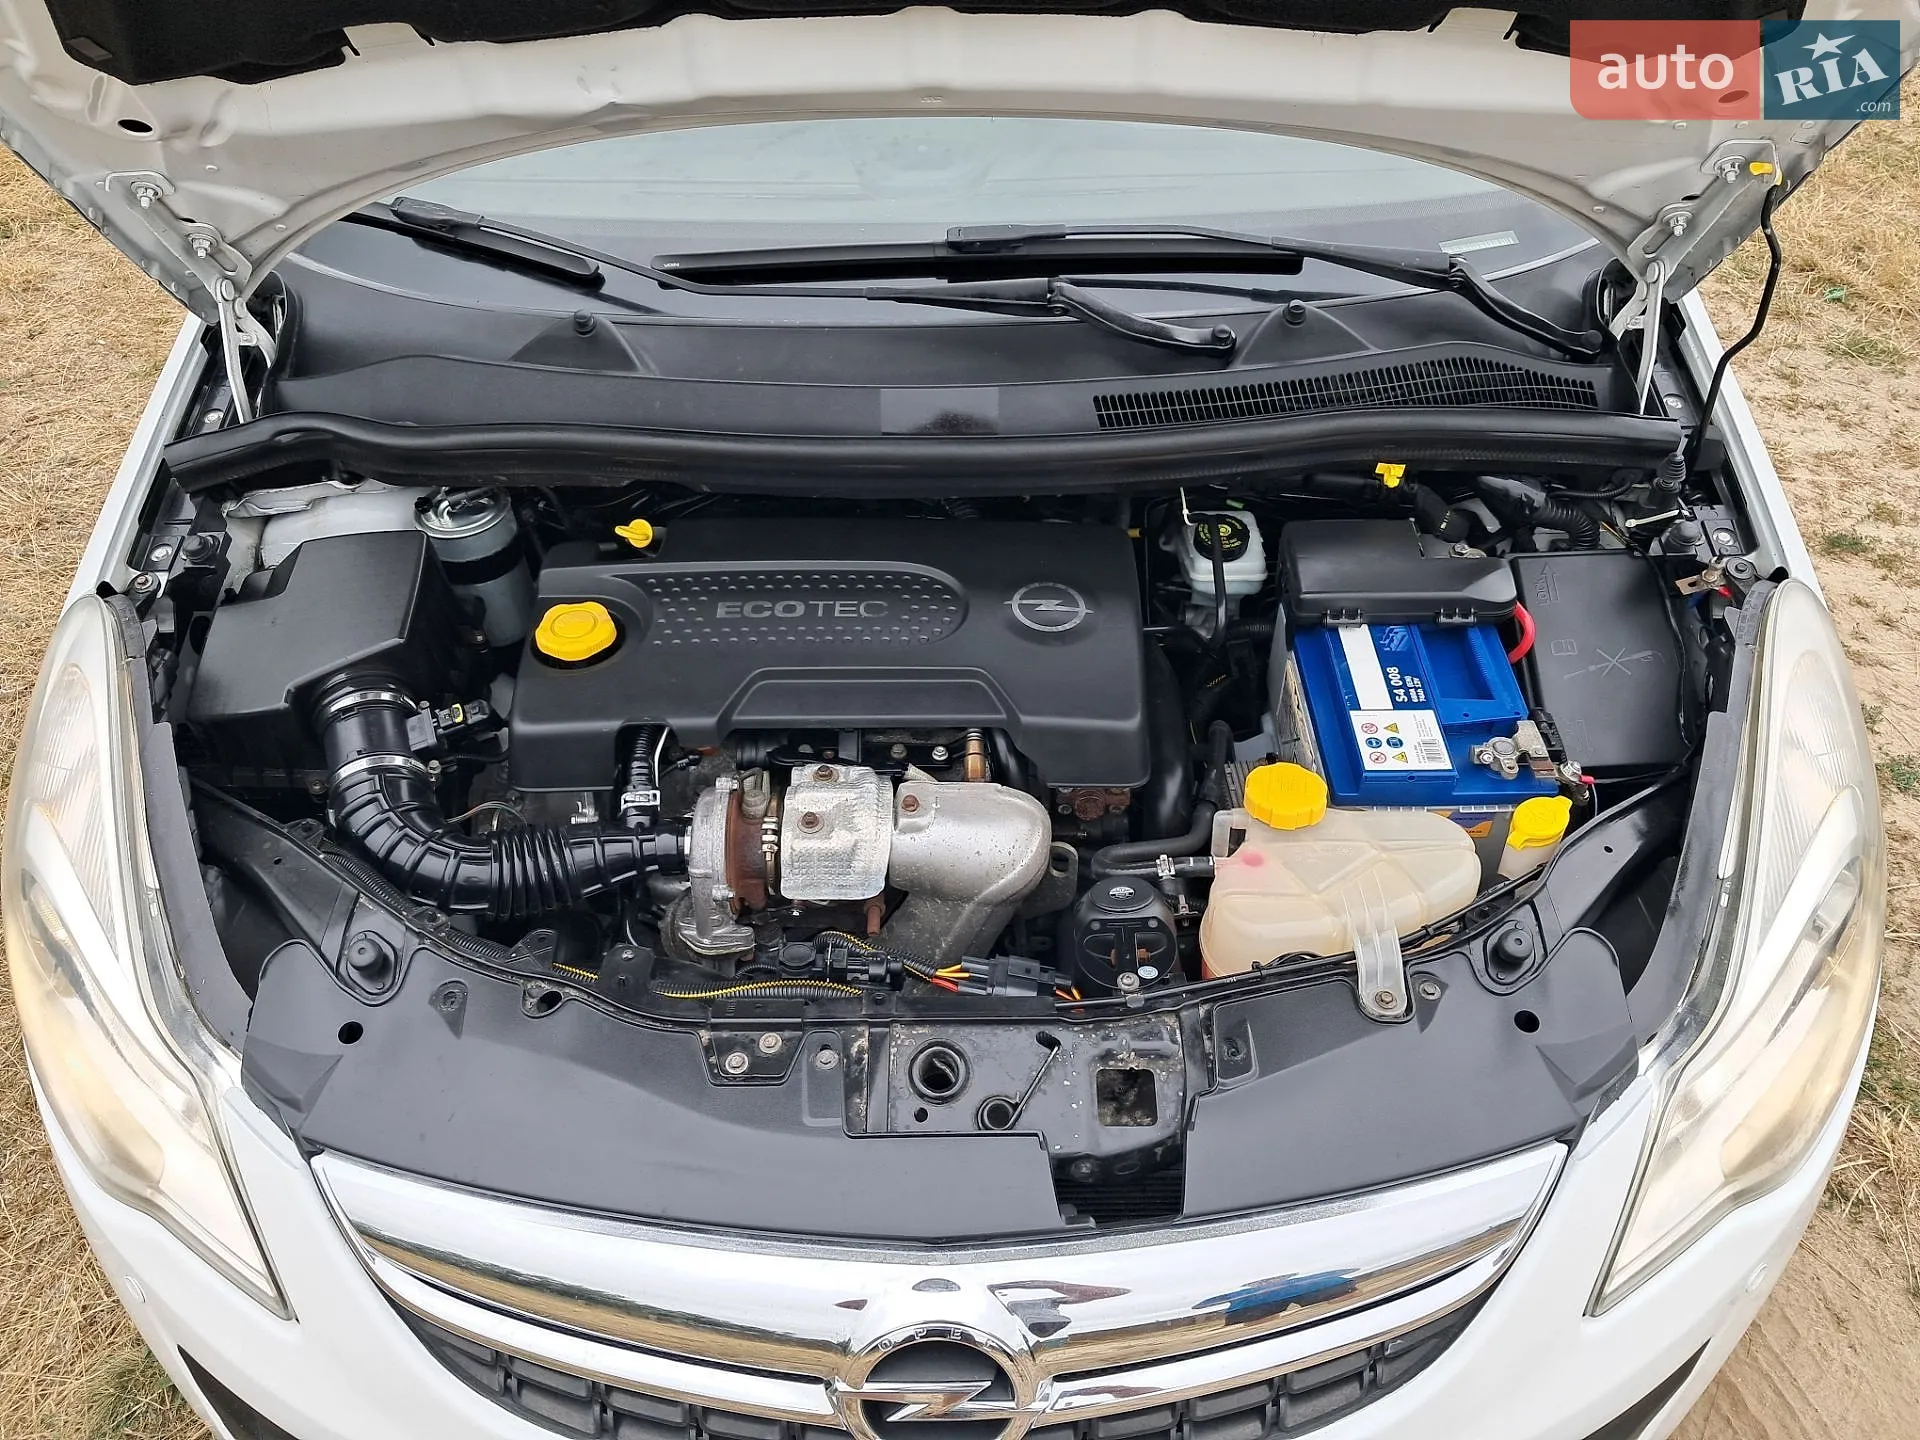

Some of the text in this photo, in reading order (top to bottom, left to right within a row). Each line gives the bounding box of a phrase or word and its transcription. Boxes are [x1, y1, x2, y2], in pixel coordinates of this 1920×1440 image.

[715, 600, 889, 618] ECOTEC
[1386, 666, 1408, 702] S4 008
[877, 1327, 998, 1352] OPEL
